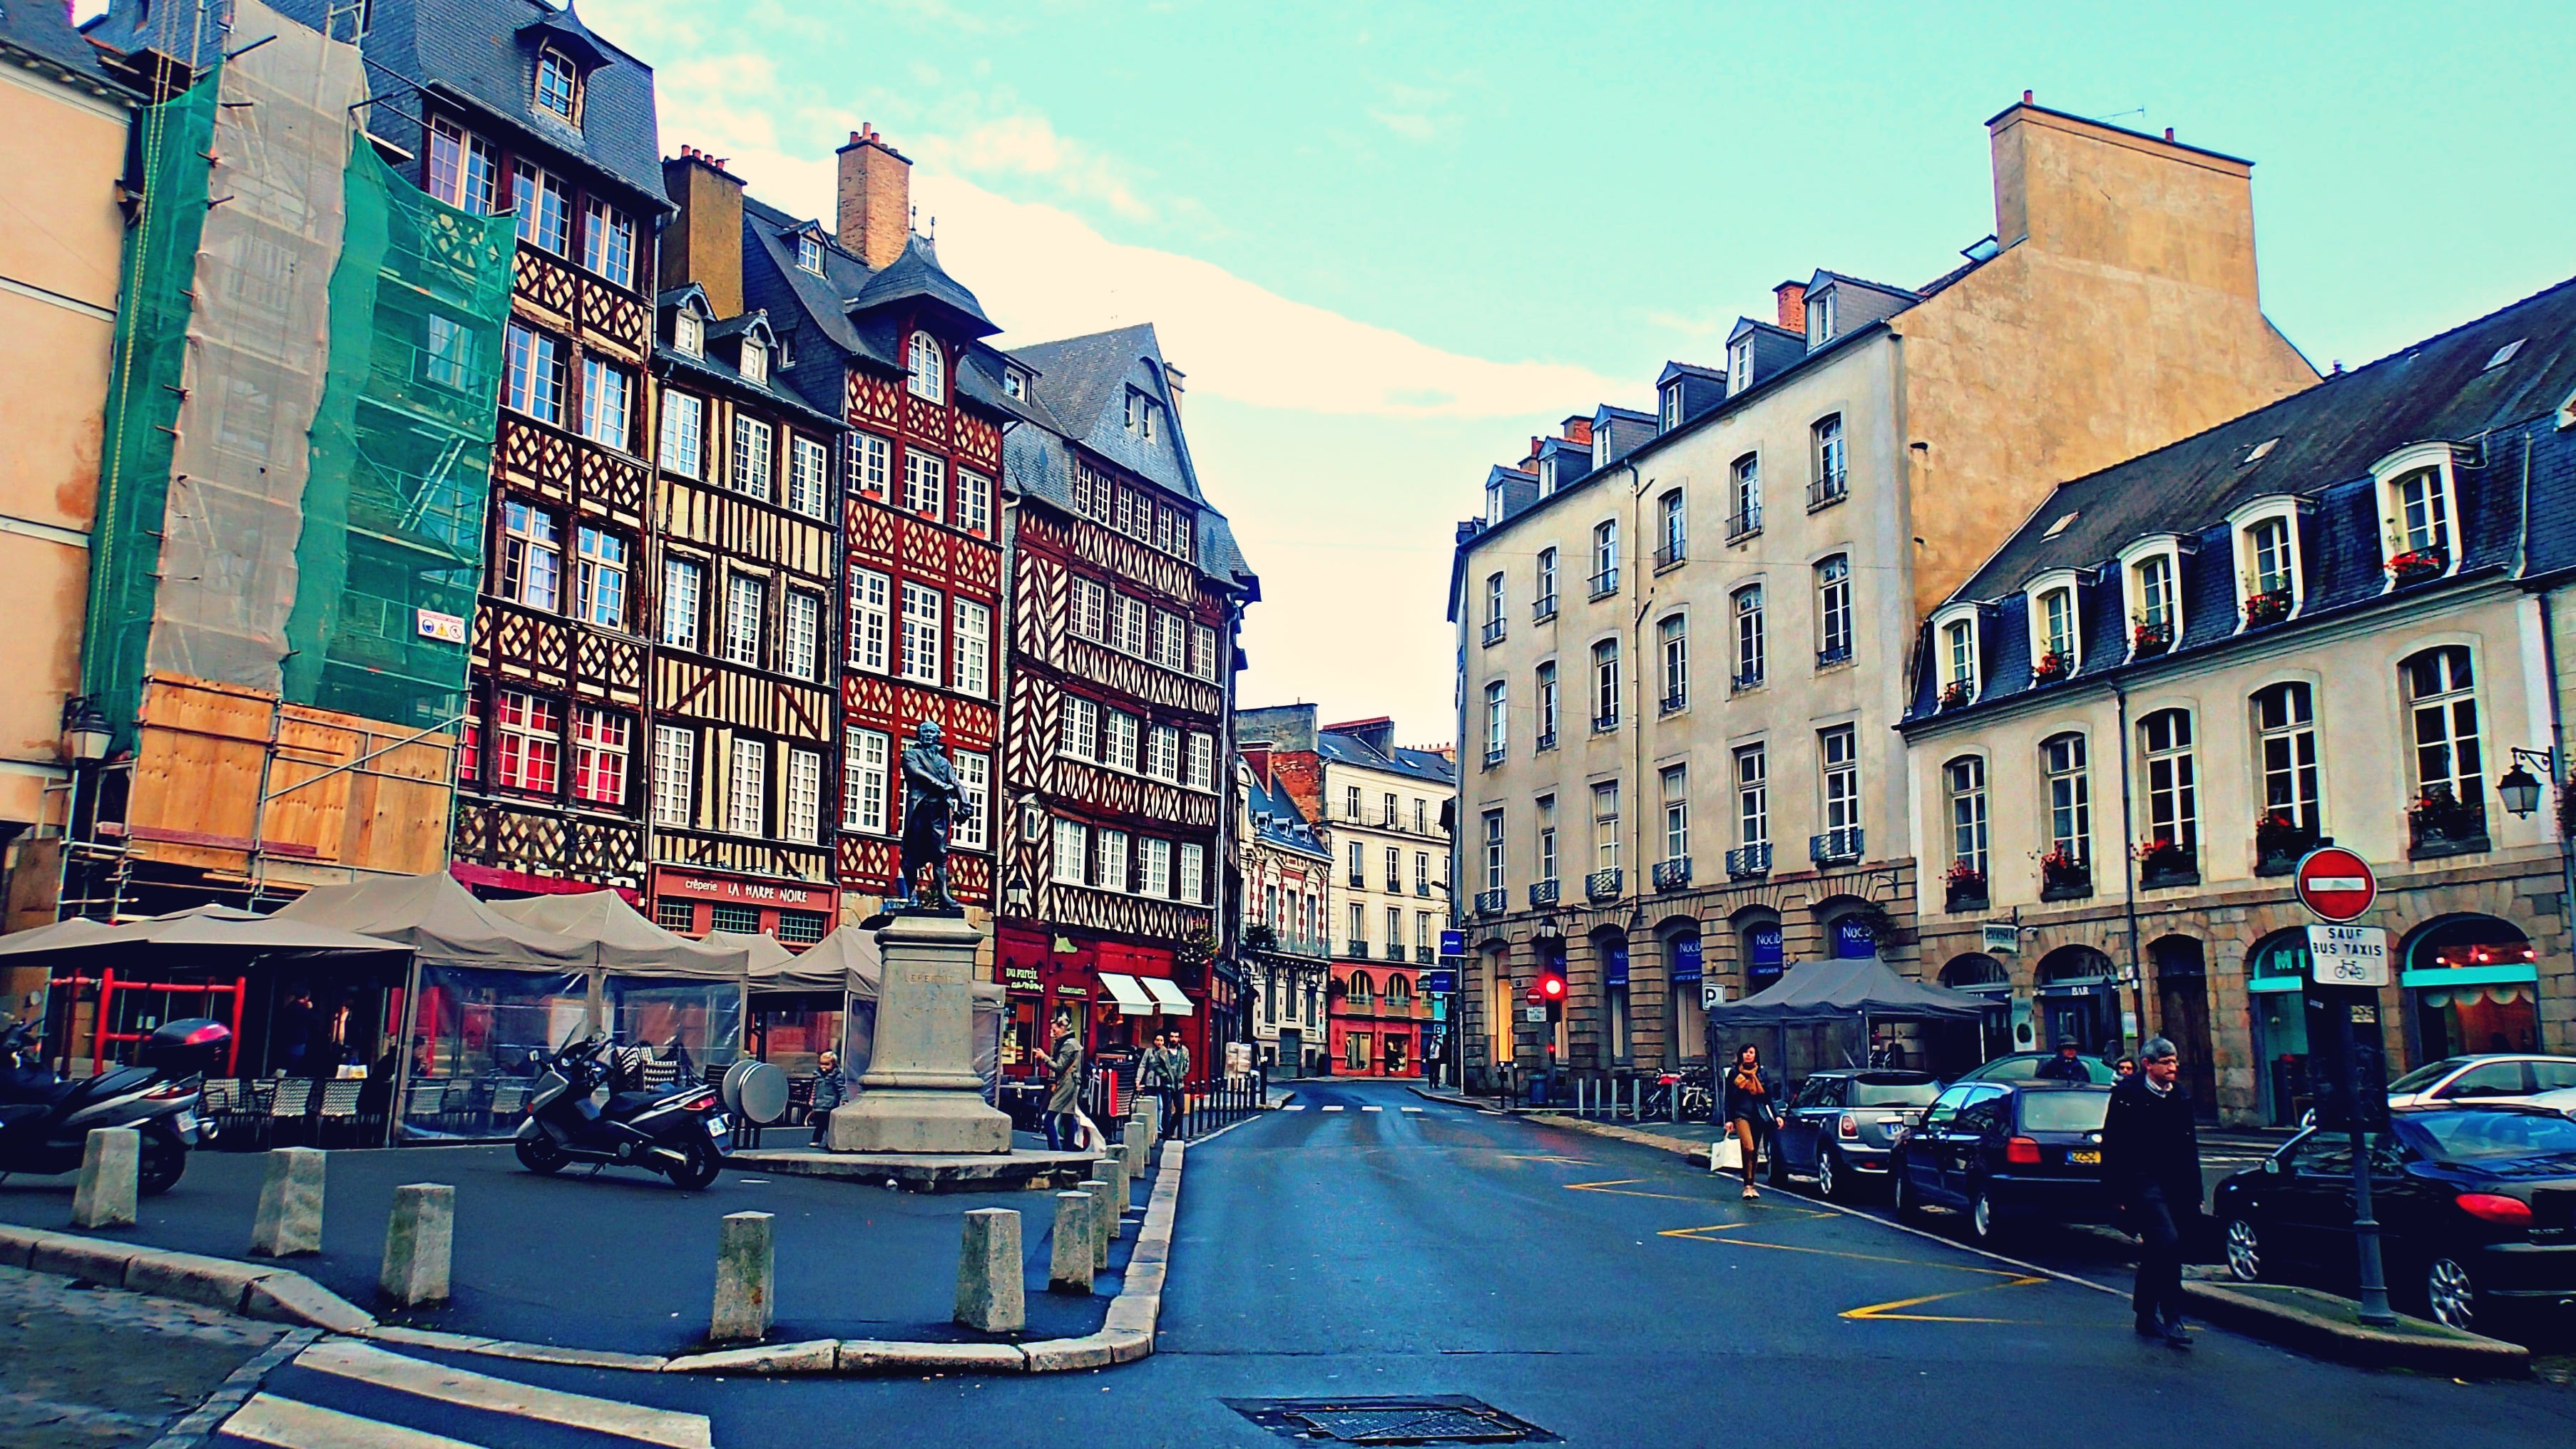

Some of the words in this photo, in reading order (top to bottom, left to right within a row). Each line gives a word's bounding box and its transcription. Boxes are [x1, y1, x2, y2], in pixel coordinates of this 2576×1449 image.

[685, 879, 718, 891] crêperie
[727, 883, 740, 897] LA
[745, 884, 775, 899] HARPE
[780, 888, 808, 903] NOIRE
[1756, 931, 1783, 946] Nocib
[2328, 928, 2363, 939] SAUF
[1680, 940, 1702, 953] Nocib
[2313, 942, 2338, 954] BUS
[2344, 943, 2382, 956] TAXIS
[1705, 988, 1717, 1003] P
[2071, 987, 2090, 996] BAR
